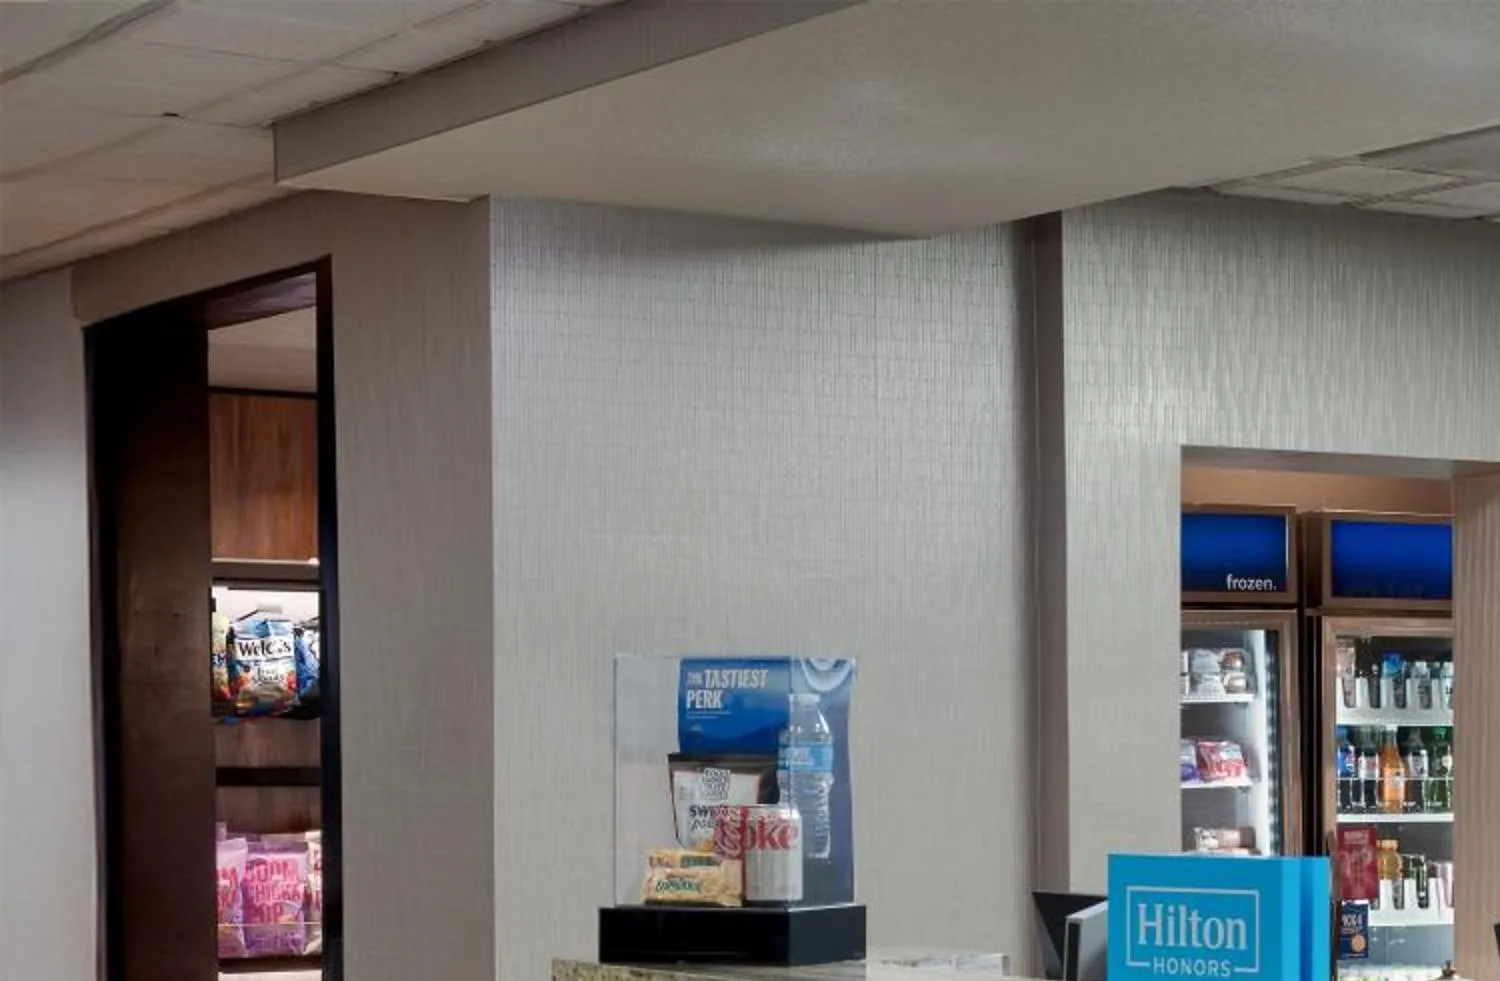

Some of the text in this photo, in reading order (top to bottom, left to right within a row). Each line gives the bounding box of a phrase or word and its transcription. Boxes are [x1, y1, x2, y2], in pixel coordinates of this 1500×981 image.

[1225, 573, 1278, 591] frozen.
[704, 668, 770, 689] TASTIEST
[686, 689, 723, 710] PERK
[1137, 903, 1248, 950] Hilton
[1153, 957, 1232, 978] HONORS
